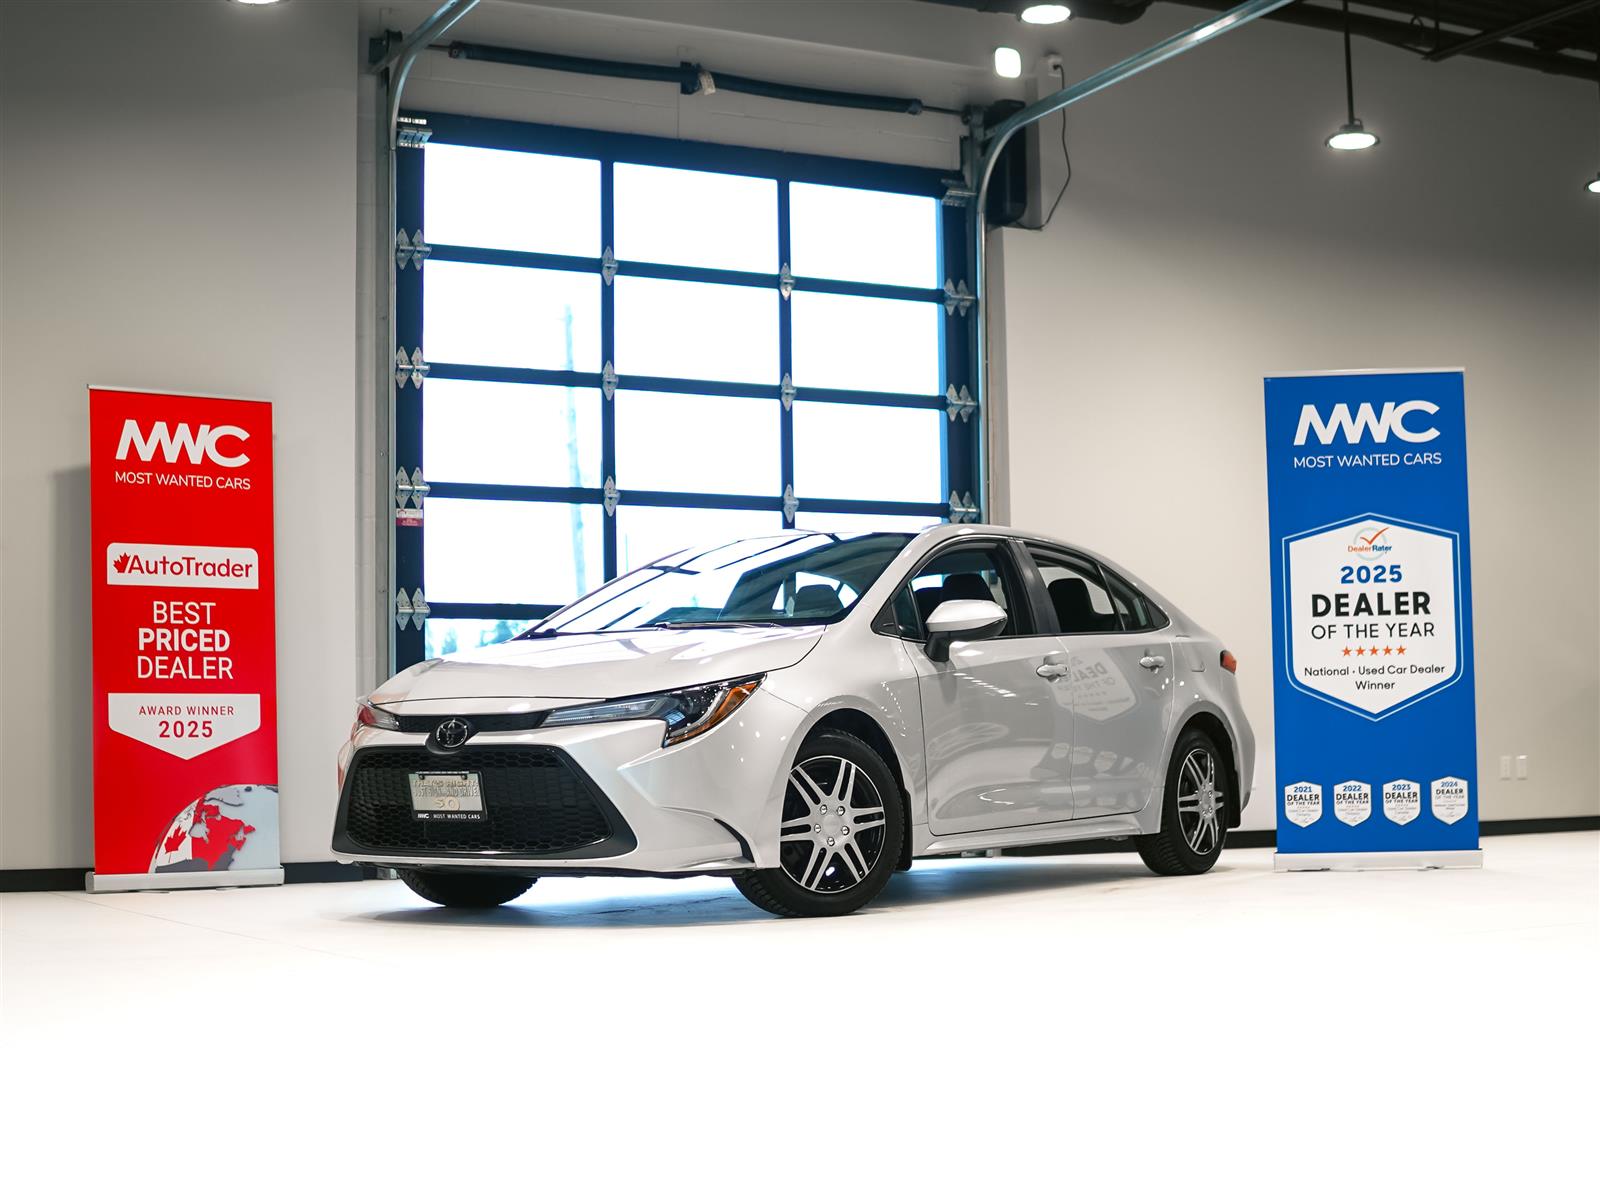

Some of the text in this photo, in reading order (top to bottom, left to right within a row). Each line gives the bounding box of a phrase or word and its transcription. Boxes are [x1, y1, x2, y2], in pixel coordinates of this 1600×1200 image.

[1293, 400, 1441, 446] MWC
[115, 419, 250, 468] MWC
[1293, 452, 1442, 469] MOST WANTED CARS
[115, 471, 251, 490] MOST WANTED CARS
[127, 555, 252, 578] AutoTrader
[1340, 565, 1403, 584] 2025
[153, 600, 216, 625] BEST
[1311, 591, 1431, 617] DEALER
[138, 628, 231, 652] PRICED
[1311, 622, 1435, 640] OF THE YEAR
[137, 655, 234, 679] DEALER
[1304, 664, 1445, 677] National Used Car Dealer
[1355, 680, 1395, 690] Winner
[138, 706, 234, 716] AWARD WINNER
[158, 720, 213, 738] 2025
[1287, 793, 1320, 801] DEALER
[1336, 793, 1369, 801] DEALER
[1385, 792, 1418, 800] DEALER
